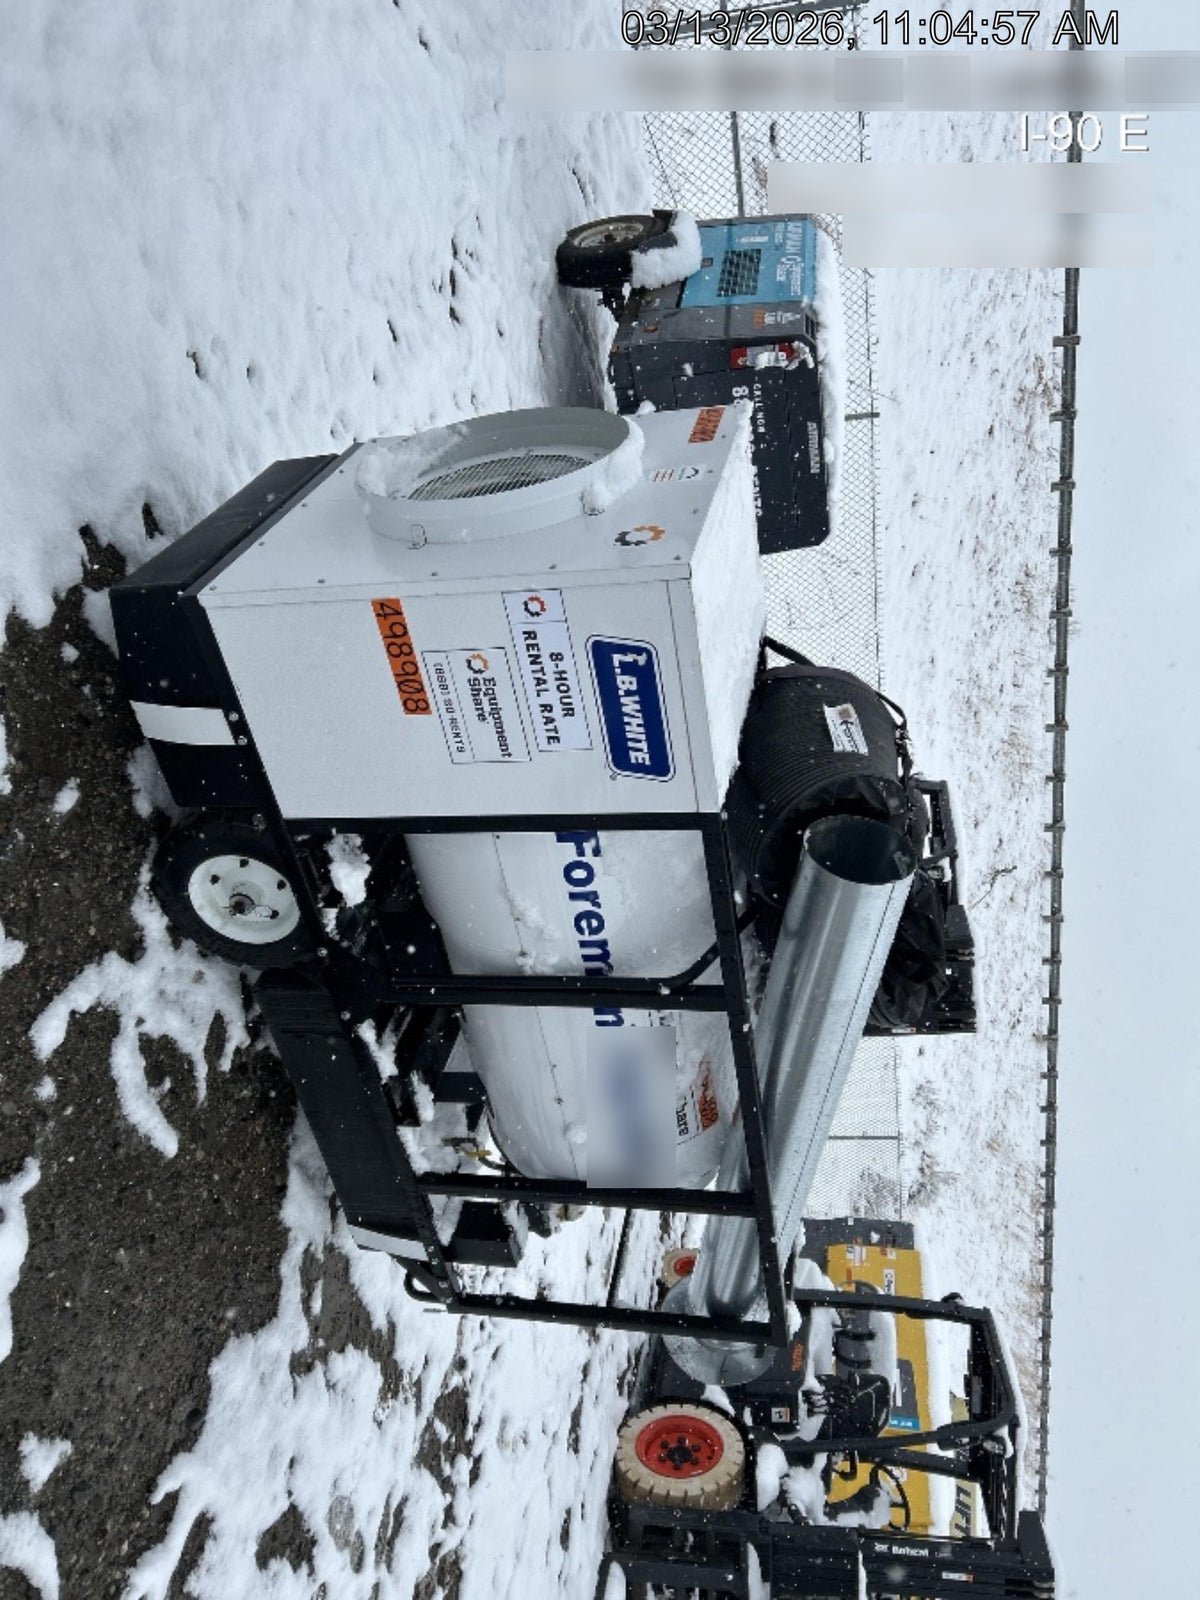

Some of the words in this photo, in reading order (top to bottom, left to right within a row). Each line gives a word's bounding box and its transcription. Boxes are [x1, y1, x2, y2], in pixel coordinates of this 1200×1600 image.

[375, 601, 430, 714] 498908
[521, 630, 550, 698] RENTAL
[538, 703, 561, 746] RATE
[548, 651, 575, 718] 8-HOUR
[466, 676, 489, 724] Share
[481, 676, 513, 759] Equipment
[557, 831, 624, 1028] Foremn
[675, 1095, 689, 1137] hare
